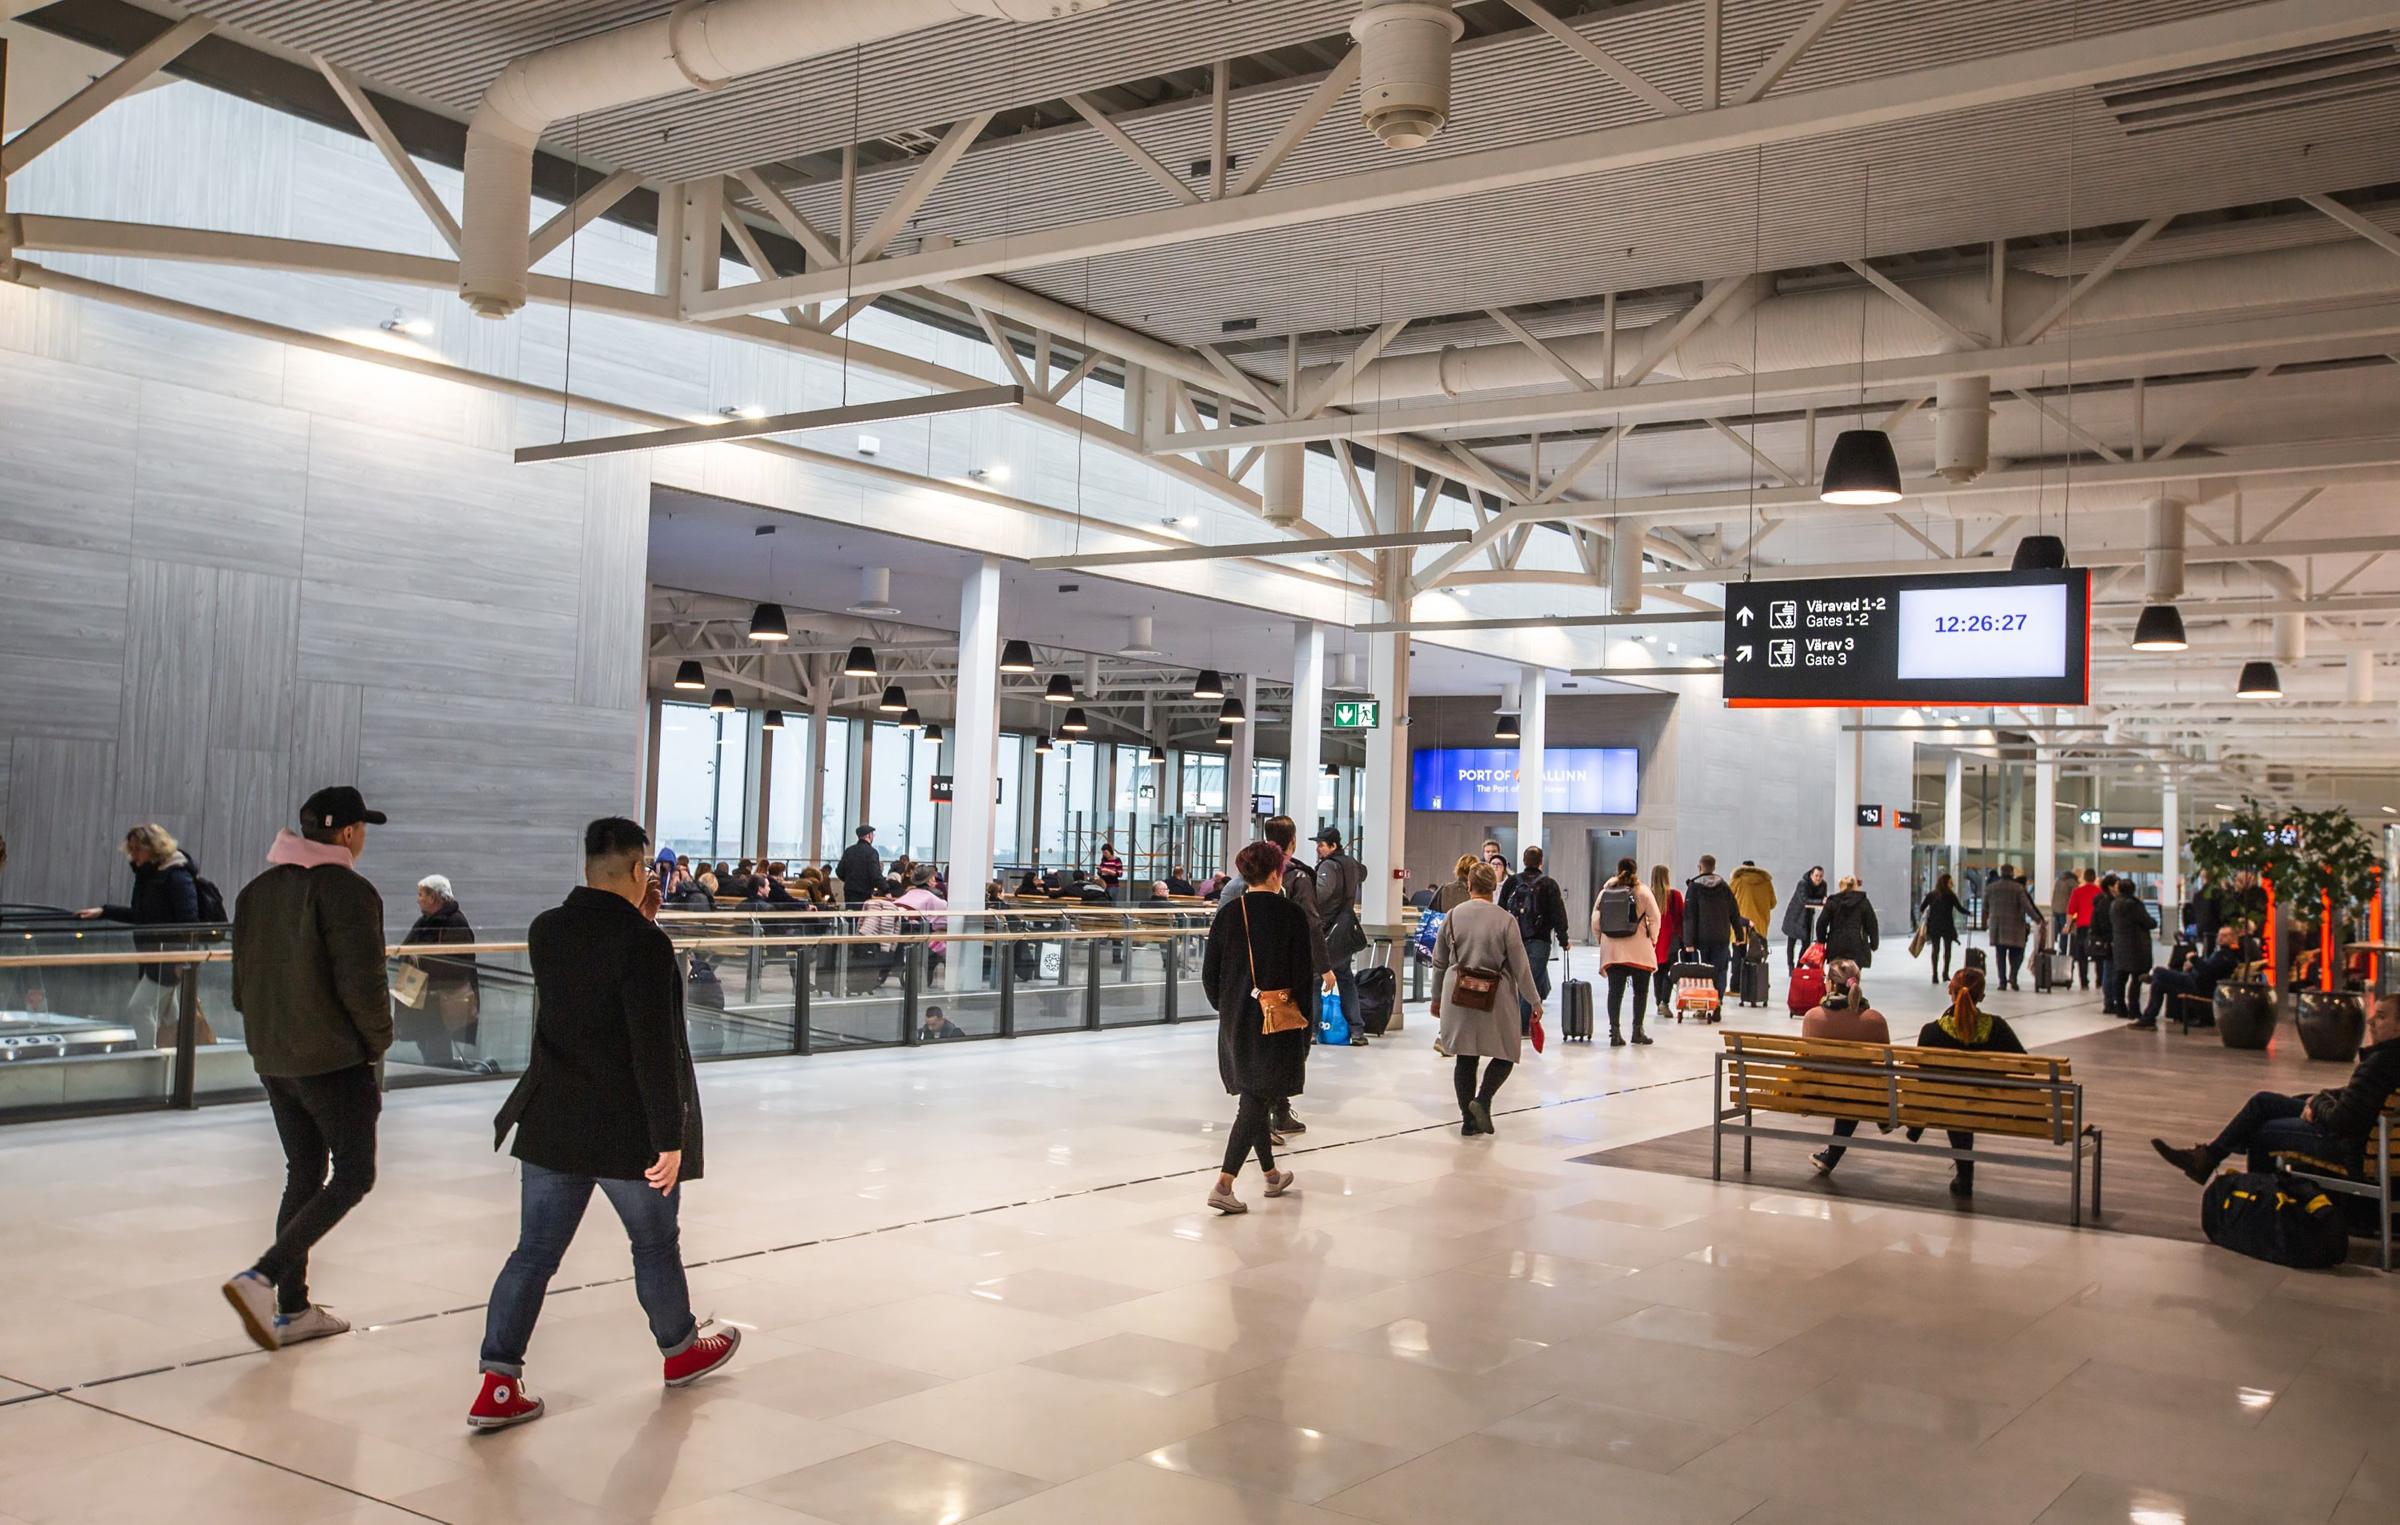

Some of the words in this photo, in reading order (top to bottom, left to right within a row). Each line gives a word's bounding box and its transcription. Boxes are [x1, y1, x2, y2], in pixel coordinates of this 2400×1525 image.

[1806, 597, 1860, 613] Väravad
[1862, 597, 1886, 611] 1-2
[1806, 614, 1843, 627] Gates
[1845, 613, 1869, 626] 1-2
[1935, 614, 2027, 632] 12:26:27
[1805, 638, 1842, 651] Värav
[1844, 637, 1855, 651] 3
[1805, 653, 1835, 666] Gate
[1837, 652, 1847, 665] 3
[1458, 769, 1492, 781] PORT
[1494, 769, 1511, 781] OF
[1542, 769, 1587, 781] LLINN
[1477, 784, 1491, 793] The
[1493, 784, 1509, 793] Port
